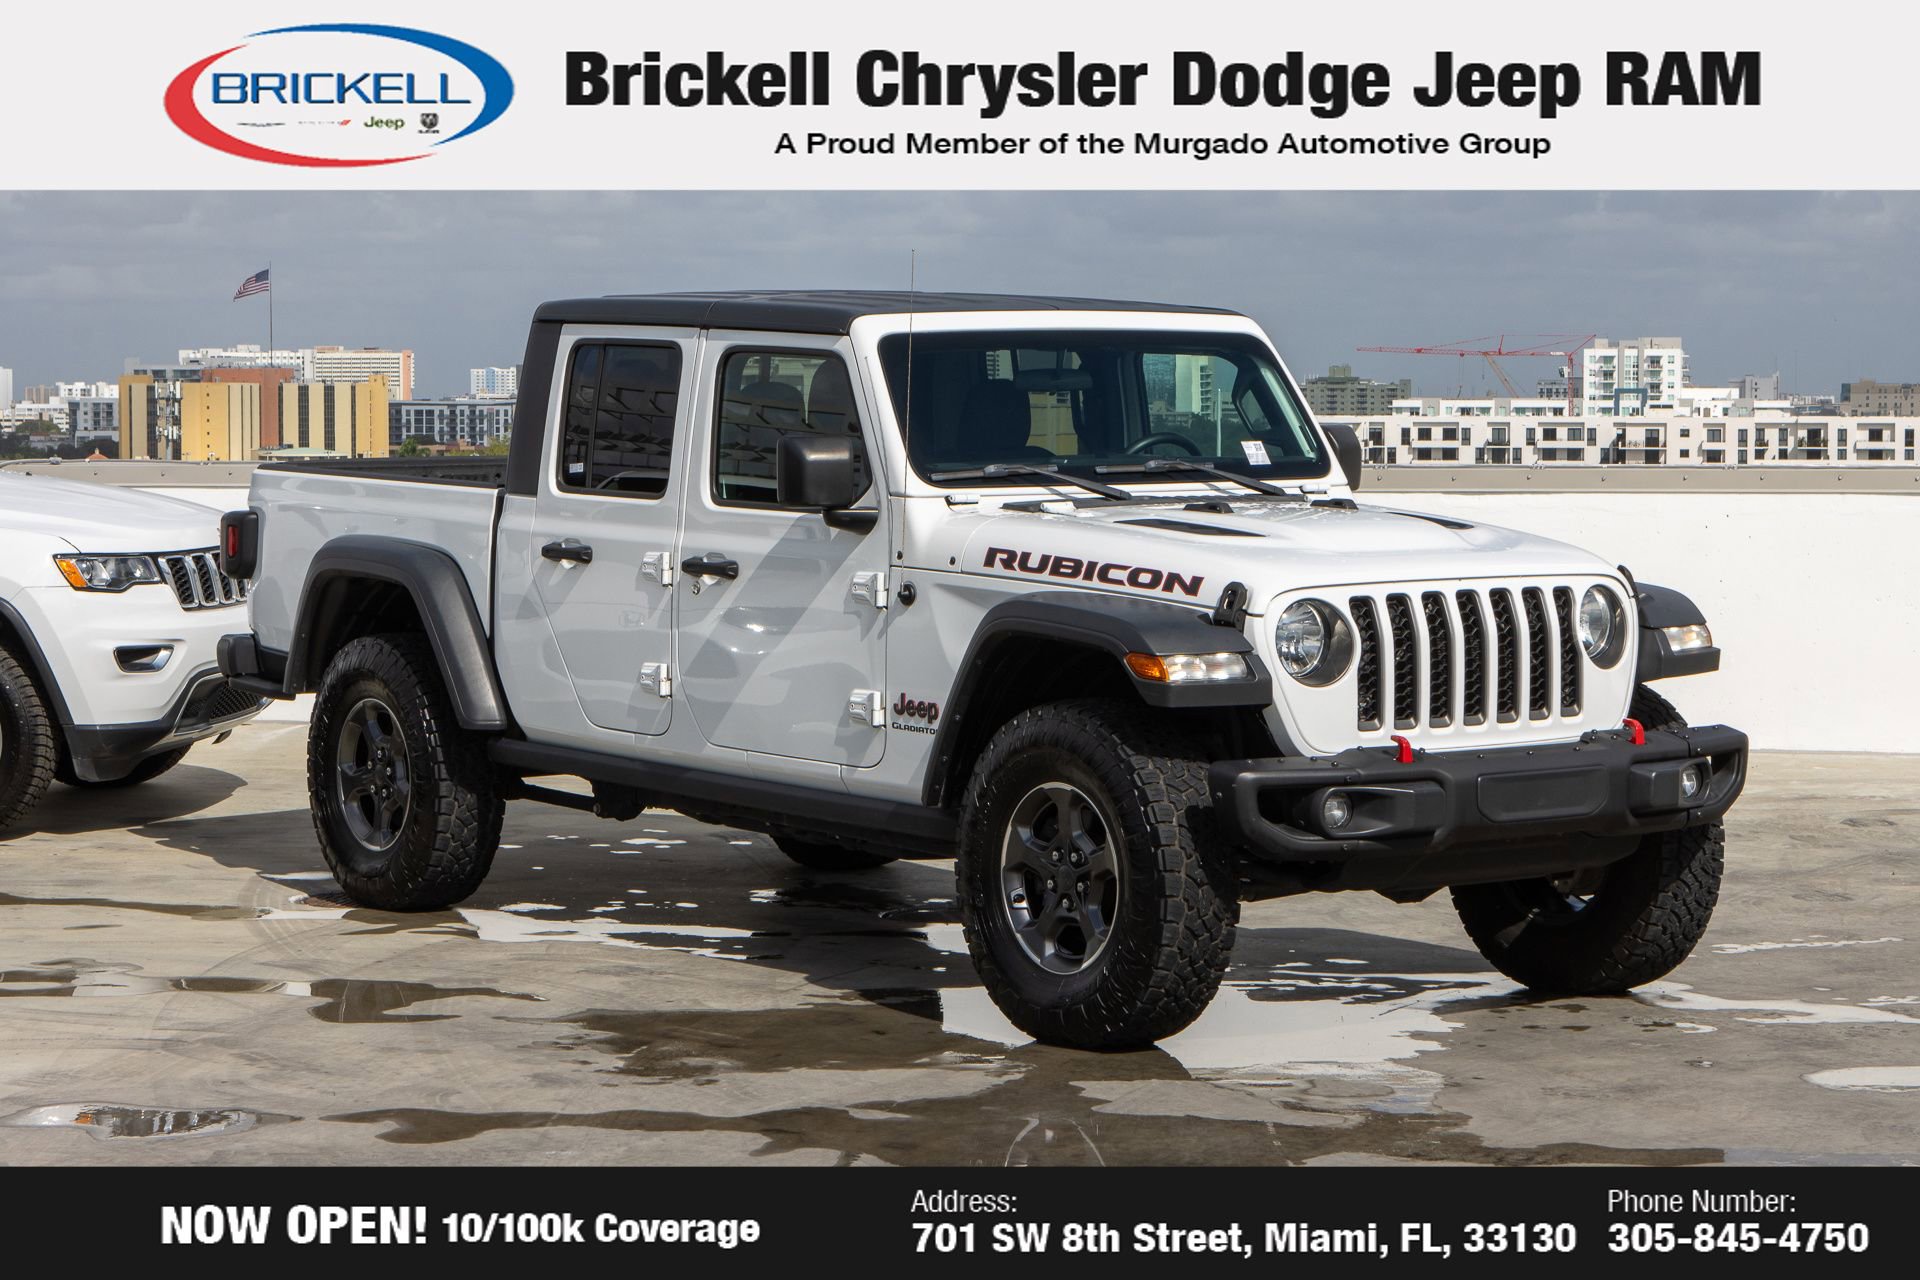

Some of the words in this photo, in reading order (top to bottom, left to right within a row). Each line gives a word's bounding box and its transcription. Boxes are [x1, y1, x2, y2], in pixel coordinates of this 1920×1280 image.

[983, 546, 1205, 598] RUBICON
[893, 692, 939, 724] Jeep
[892, 721, 938, 735] GLADIATO
